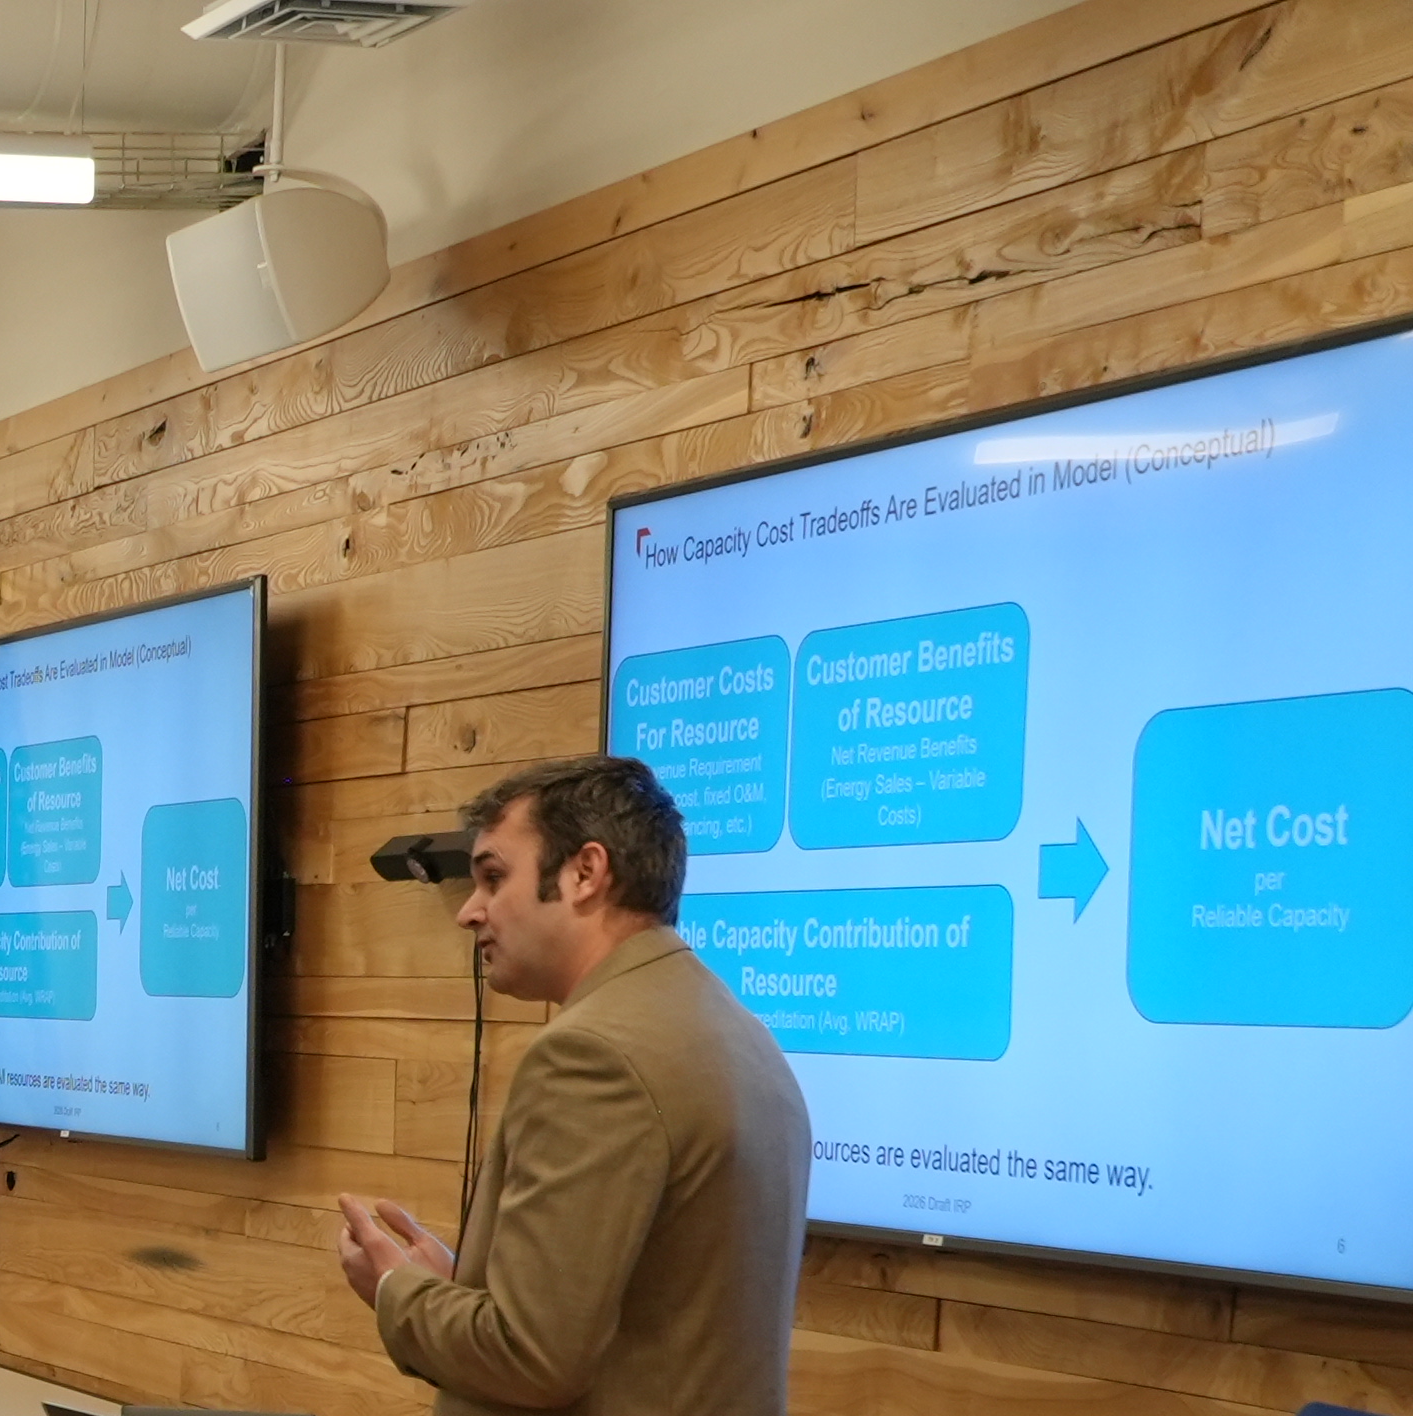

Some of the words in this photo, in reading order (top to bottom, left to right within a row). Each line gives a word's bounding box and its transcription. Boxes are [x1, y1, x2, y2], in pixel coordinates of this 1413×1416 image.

[645, 541, 679, 569] How
[683, 526, 751, 564] Capacity
[756, 516, 794, 547] Cost
[799, 499, 880, 540] Tradeoffs
[884, 495, 917, 524] Are
[924, 470, 1020, 516] Evaluated
[1028, 470, 1045, 496] in
[1053, 451, 1118, 491] Model
[1125, 418, 1275, 484] (Conceptual)
[45, 664, 58, 682] Are
[60, 654, 98, 680] Evaluated
[100, 653, 108, 671] in
[110, 646, 134, 669] Model
[136, 635, 191, 668] (Conceptual)
[807, 650, 911, 686] Customer
[918, 631, 1015, 673] Benefits
[626, 675, 714, 707] Customer
[719, 663, 773, 695] Costs
[838, 699, 861, 731] of
[866, 694, 974, 729] Resource
[636, 722, 666, 750] For
[671, 717, 759, 747] Resource
[832, 745, 855, 766] Net
[858, 743, 916, 764] Revenue
[921, 734, 978, 760] Benefits
[14, 762, 57, 782] Customer
[59, 753, 97, 776] Benefits
[653, 763, 686, 780] venue
[689, 754, 762, 780] Requirement
[704, 786, 729, 805] fixed
[821, 777, 871, 801] (Energy
[875, 773, 912, 796] Sales
[930, 767, 987, 790] Variable
[27, 792, 37, 812] of
[39, 791, 81, 811] Resource
[878, 804, 921, 828] Costs)
[682, 819, 723, 839] ancing,
[726, 815, 752, 837] etc.)
[1200, 808, 1256, 850] Net
[1266, 803, 1349, 847] Cost
[166, 866, 187, 891] Net
[190, 865, 219, 890] Cost
[1254, 872, 1287, 896] per
[1191, 904, 1263, 928] Reliable
[1268, 902, 1351, 932] Capacity
[13, 930, 68, 951] Contribution
[71, 930, 81, 949] of
[712, 919, 797, 956] Capacity
[804, 916, 939, 949] Contribution
[946, 914, 971, 948] of
[741, 966, 837, 998] Resource
[754, 1009, 815, 1029] reditation
[855, 1011, 905, 1036] WRAP)
[7, 1071, 41, 1088] resources
[42, 1076, 55, 1090] are
[57, 1073, 93, 1093] evaluated
[94, 1076, 107, 1094] the
[108, 1080, 130, 1097] same
[132, 1082, 150, 1102] way.
[813, 1140, 870, 1164] ources
[876, 1145, 904, 1168] are
[910, 1144, 1001, 1176] evaluated
[1007, 1150, 1037, 1179] the
[1044, 1158, 1100, 1185] same
[1107, 1163, 1154, 1197] way.
[928, 1196, 951, 1212] Draft
[953, 1199, 971, 1213] IRP
[1337, 1238, 1346, 1254] 6
